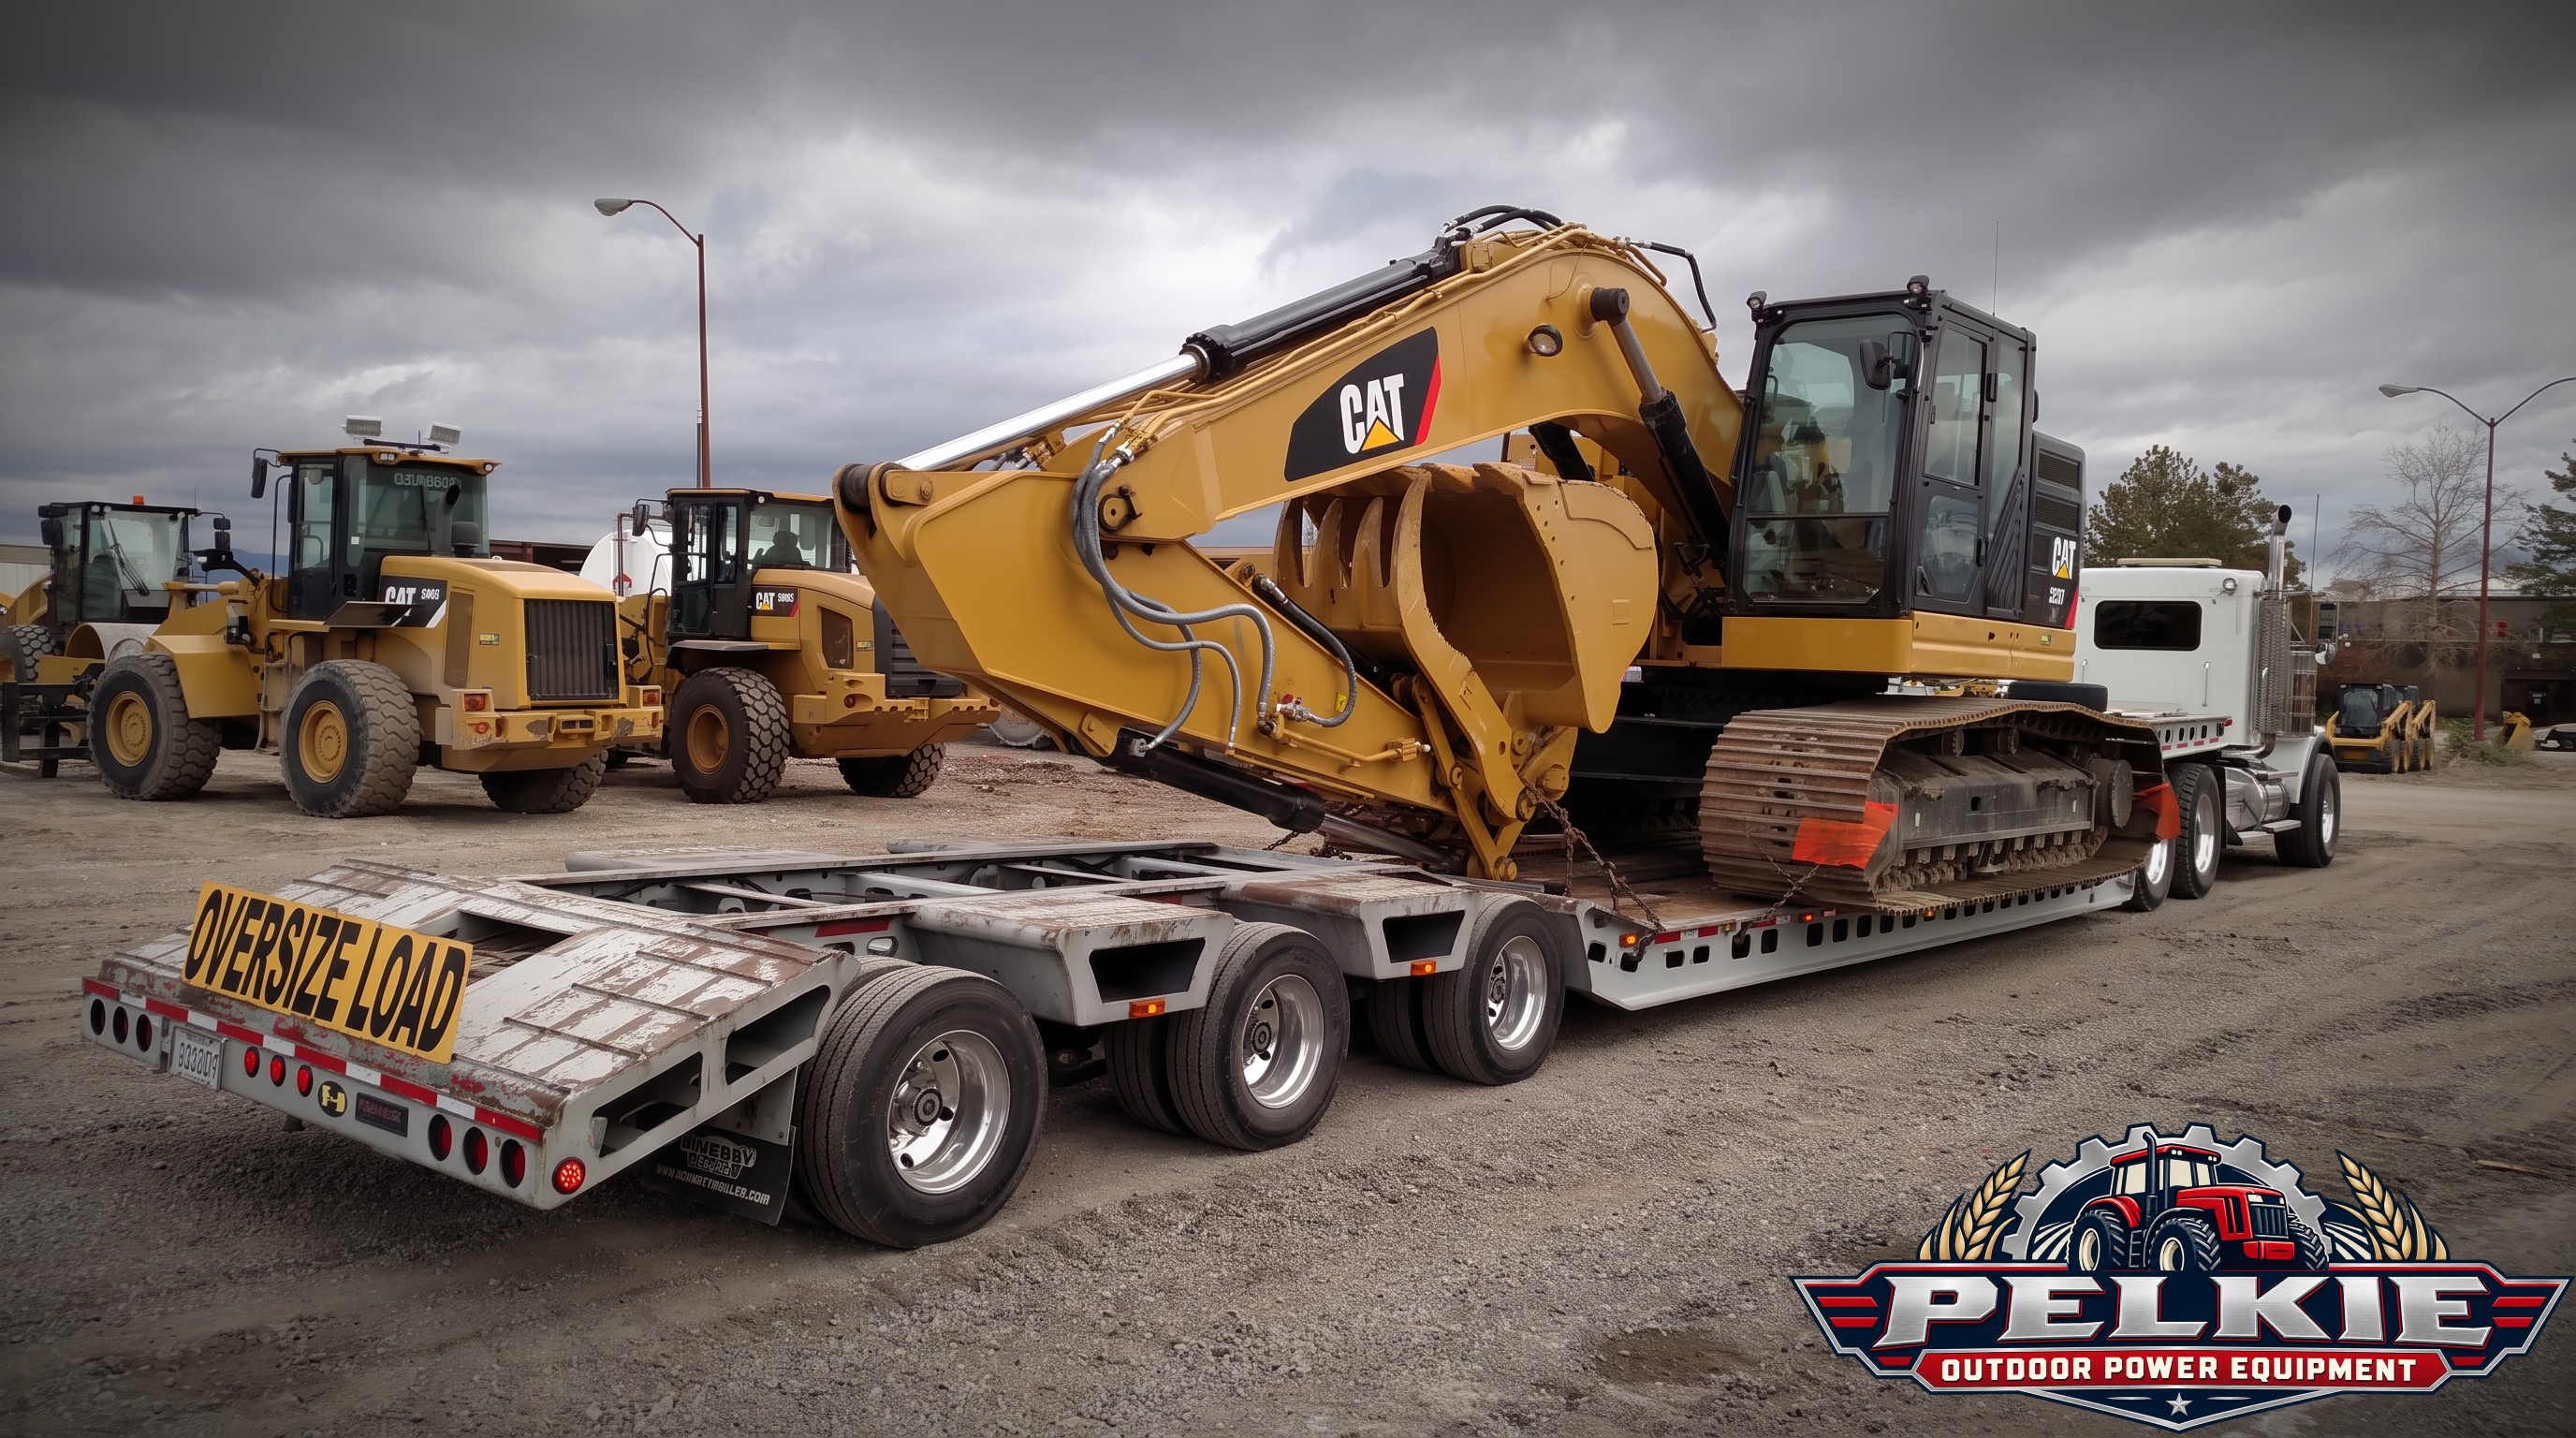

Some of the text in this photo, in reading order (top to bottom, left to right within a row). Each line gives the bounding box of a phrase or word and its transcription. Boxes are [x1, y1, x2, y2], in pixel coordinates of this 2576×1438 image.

[1339, 373, 1405, 454] CAT
[2052, 536, 2077, 580] CAT
[384, 586, 417, 605] CAT
[755, 592, 775, 611] CAT
[183, 888, 467, 1053] OVERSIZE LOAD
